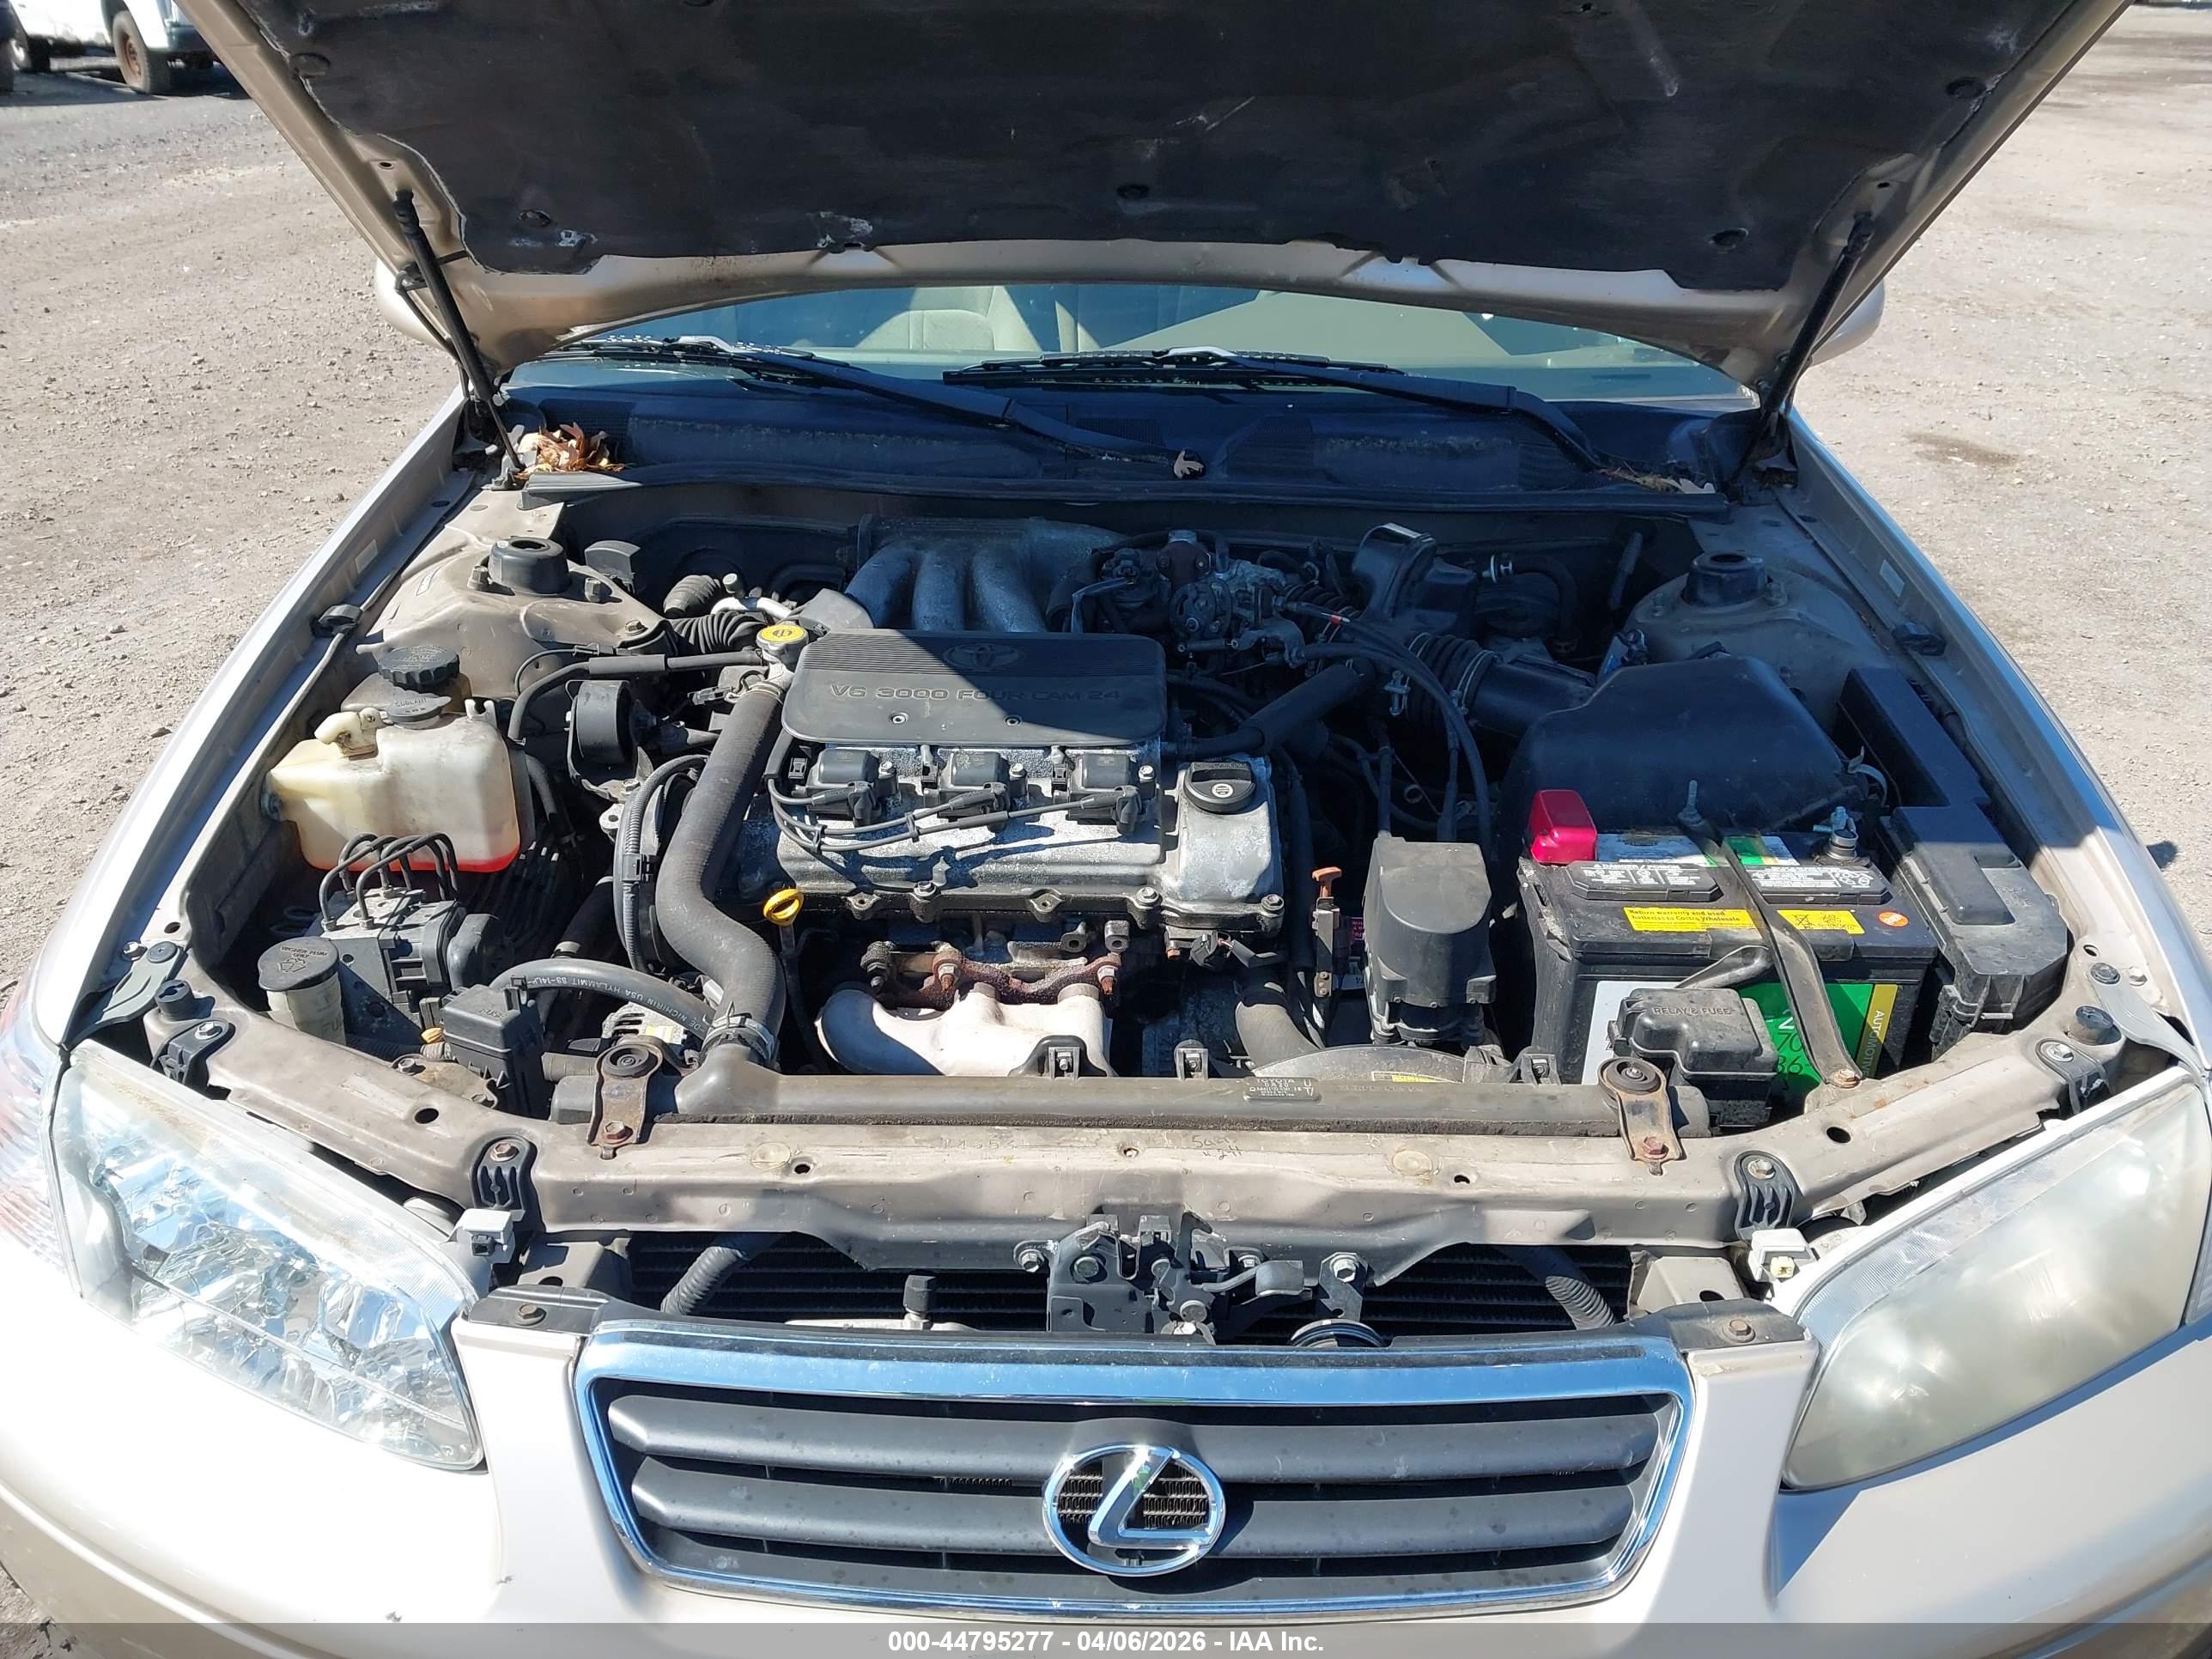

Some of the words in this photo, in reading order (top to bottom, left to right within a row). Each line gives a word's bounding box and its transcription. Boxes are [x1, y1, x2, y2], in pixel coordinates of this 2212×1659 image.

[831, 684, 866, 698] V6
[876, 687, 949, 700] 3000
[957, 689, 1024, 701] FOUR
[1033, 690, 1080, 701] CAM
[1088, 690, 1121, 701] 24
[625, 989, 644, 1002] USA
[1651, 1006, 1688, 1016] RELAY
[1700, 1007, 1733, 1017] FUSE
